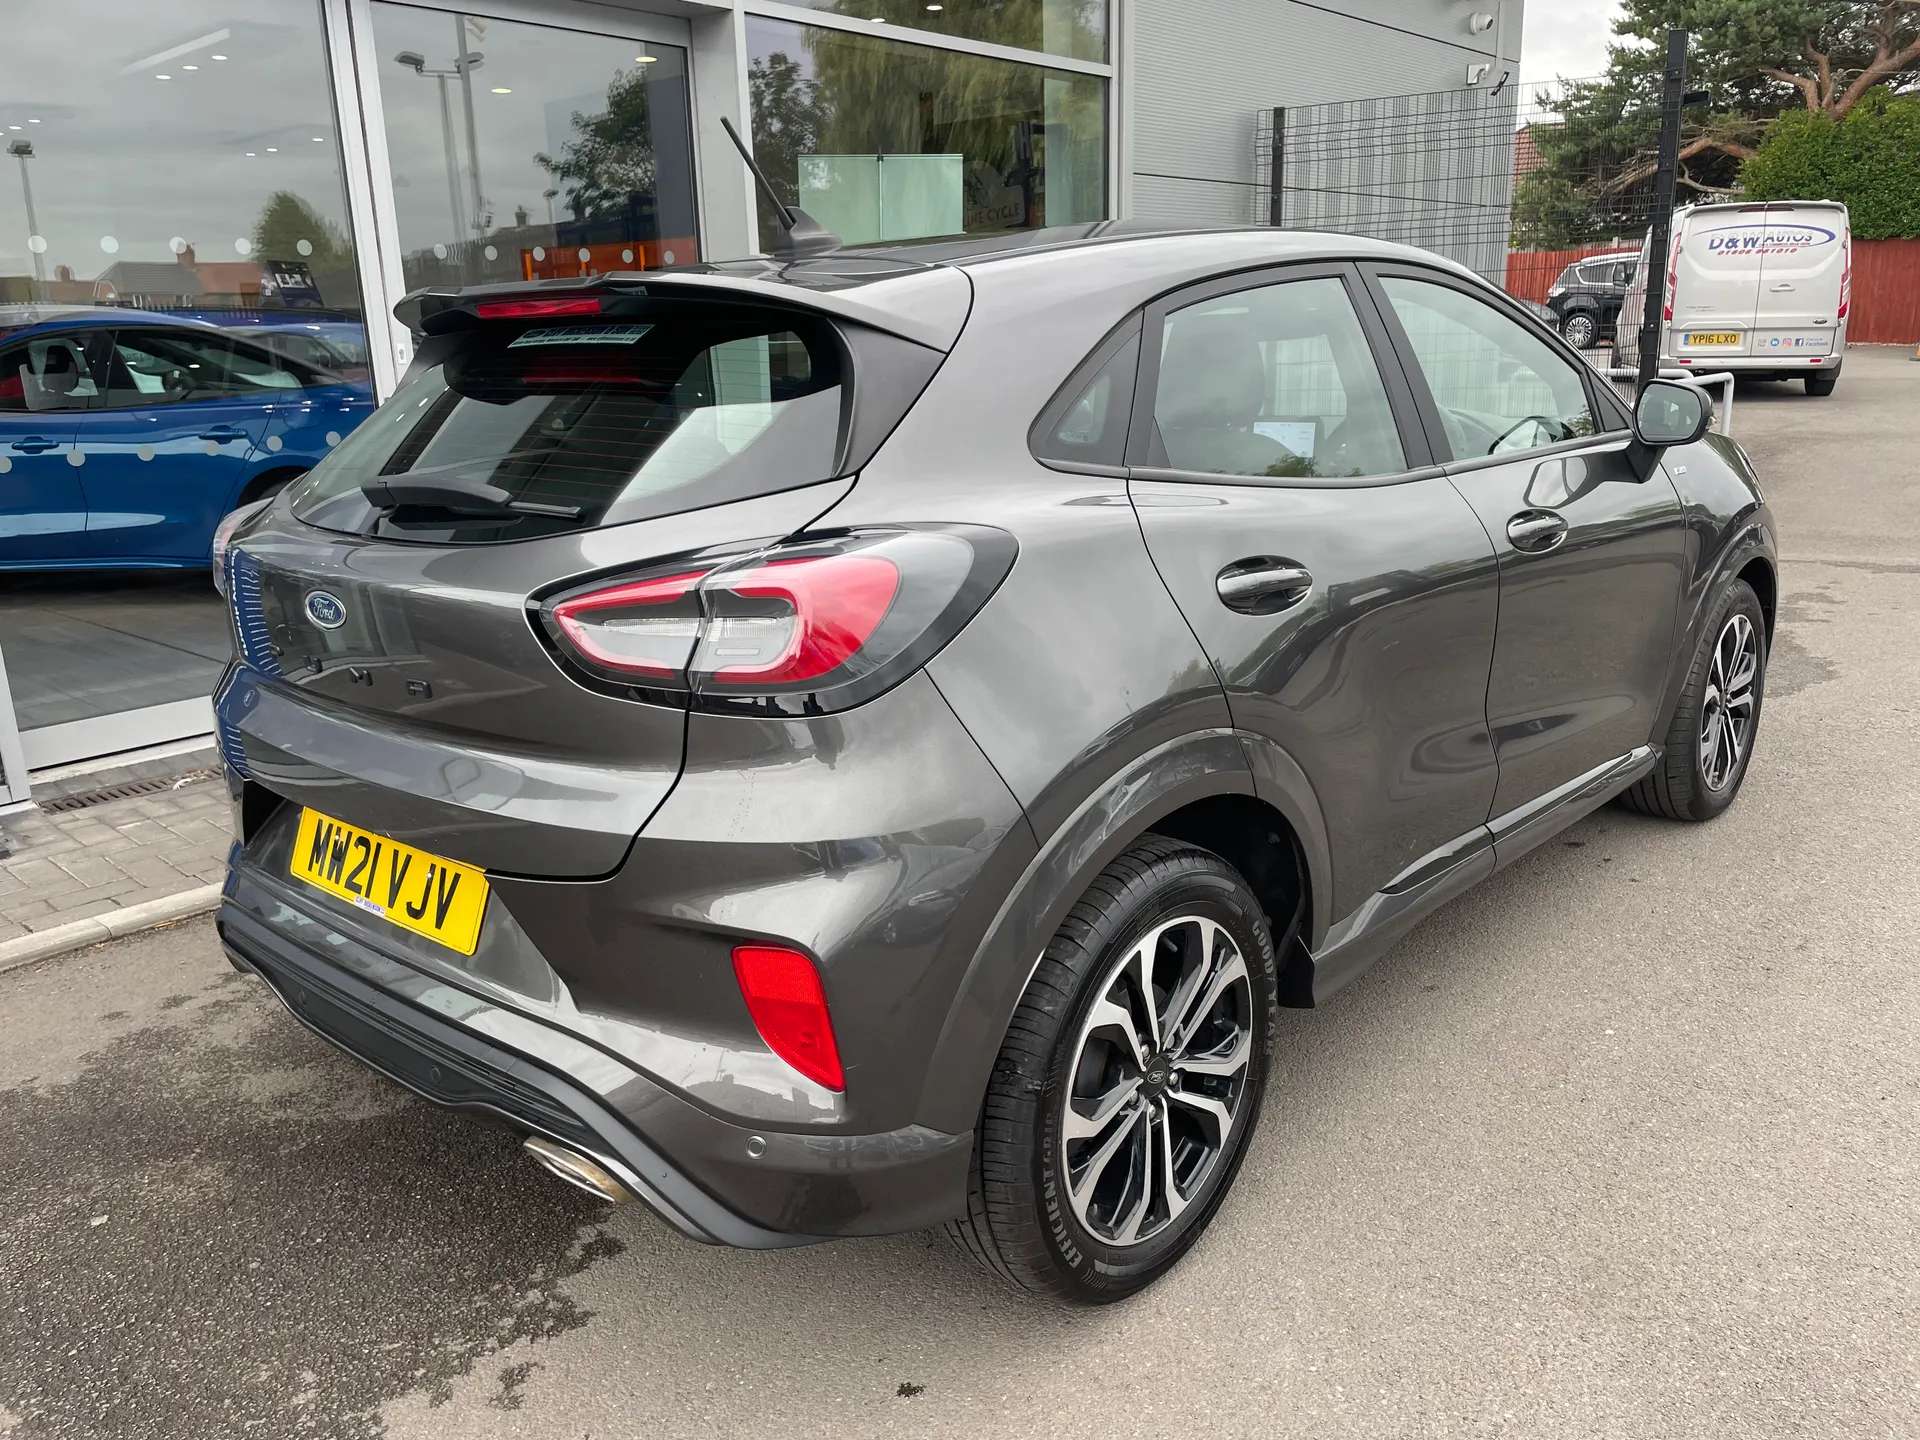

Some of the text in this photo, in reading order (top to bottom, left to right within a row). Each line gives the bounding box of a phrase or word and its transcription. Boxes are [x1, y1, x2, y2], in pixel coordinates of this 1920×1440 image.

[1692, 334, 1737, 344] YP16 LXO
[313, 597, 336, 621] Ford
[307, 818, 462, 931] MW21 VJV
